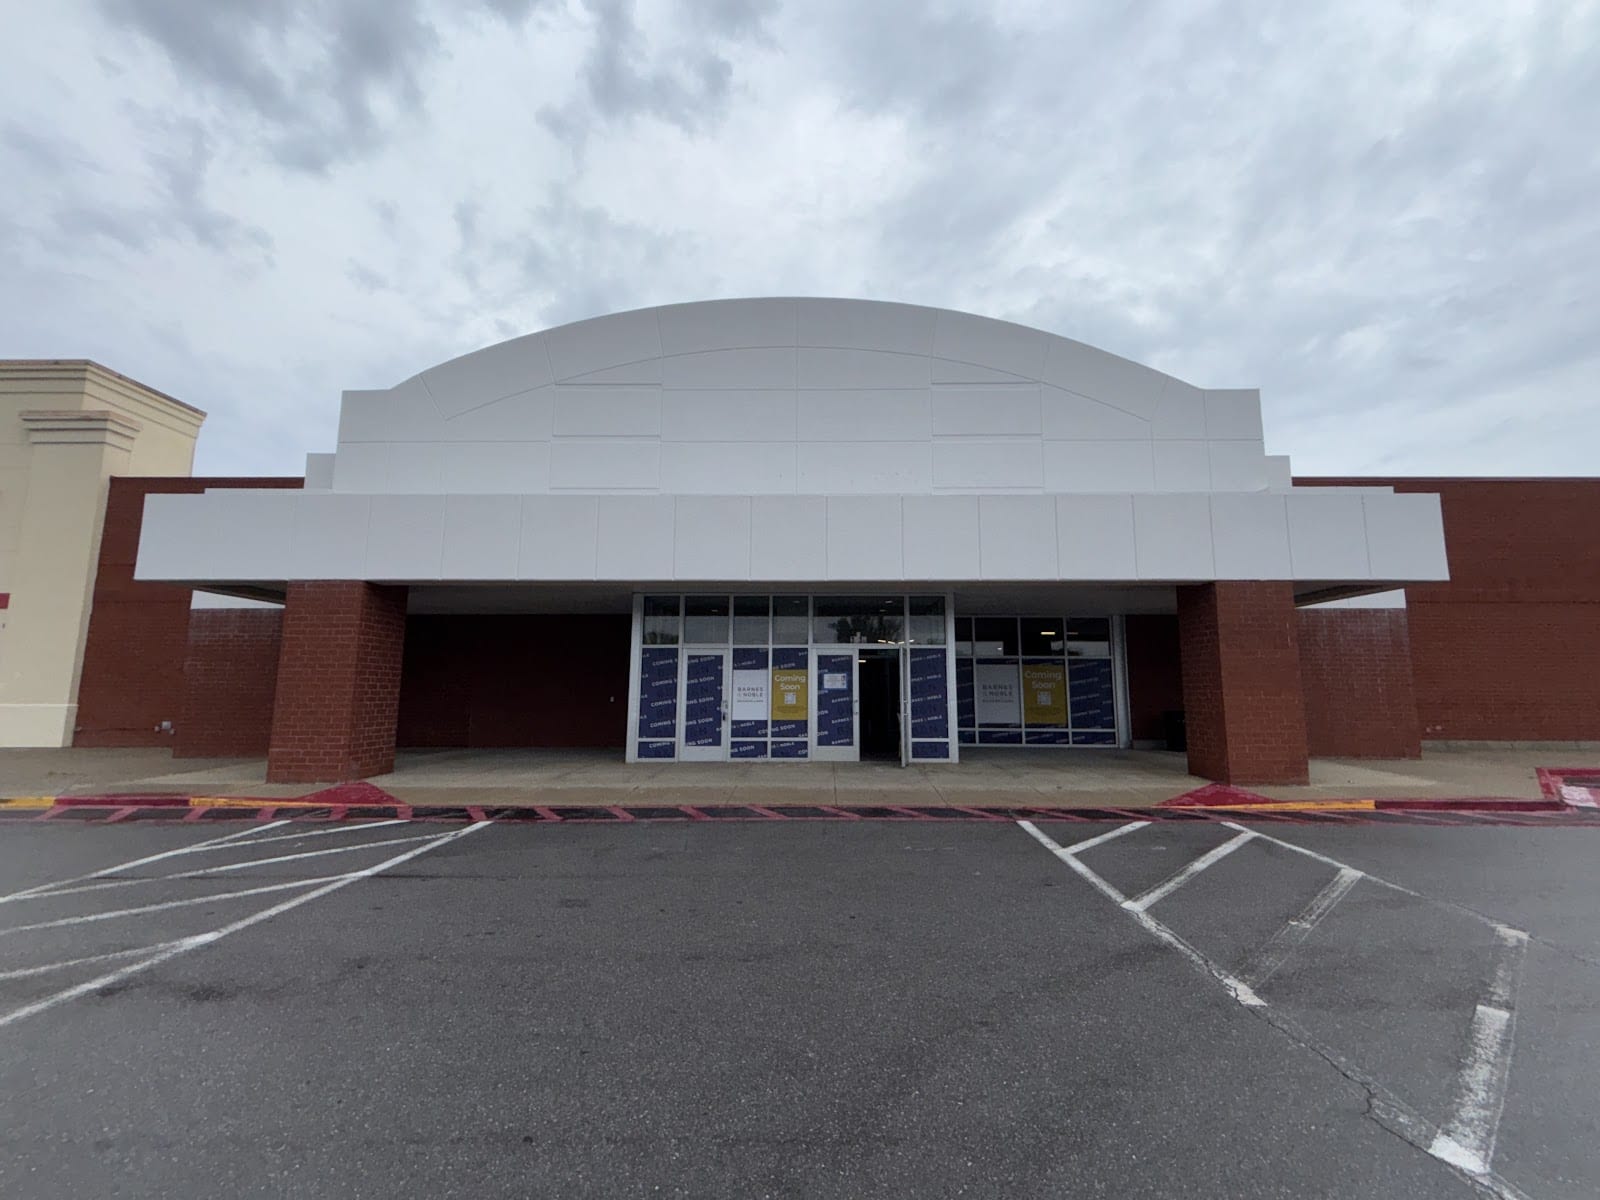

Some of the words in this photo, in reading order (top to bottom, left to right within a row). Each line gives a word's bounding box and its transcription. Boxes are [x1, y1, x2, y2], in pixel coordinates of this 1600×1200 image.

[774, 674, 806, 683] Coming
[1025, 671, 1063, 681] Coming
[1032, 681, 1056, 689] Soon
